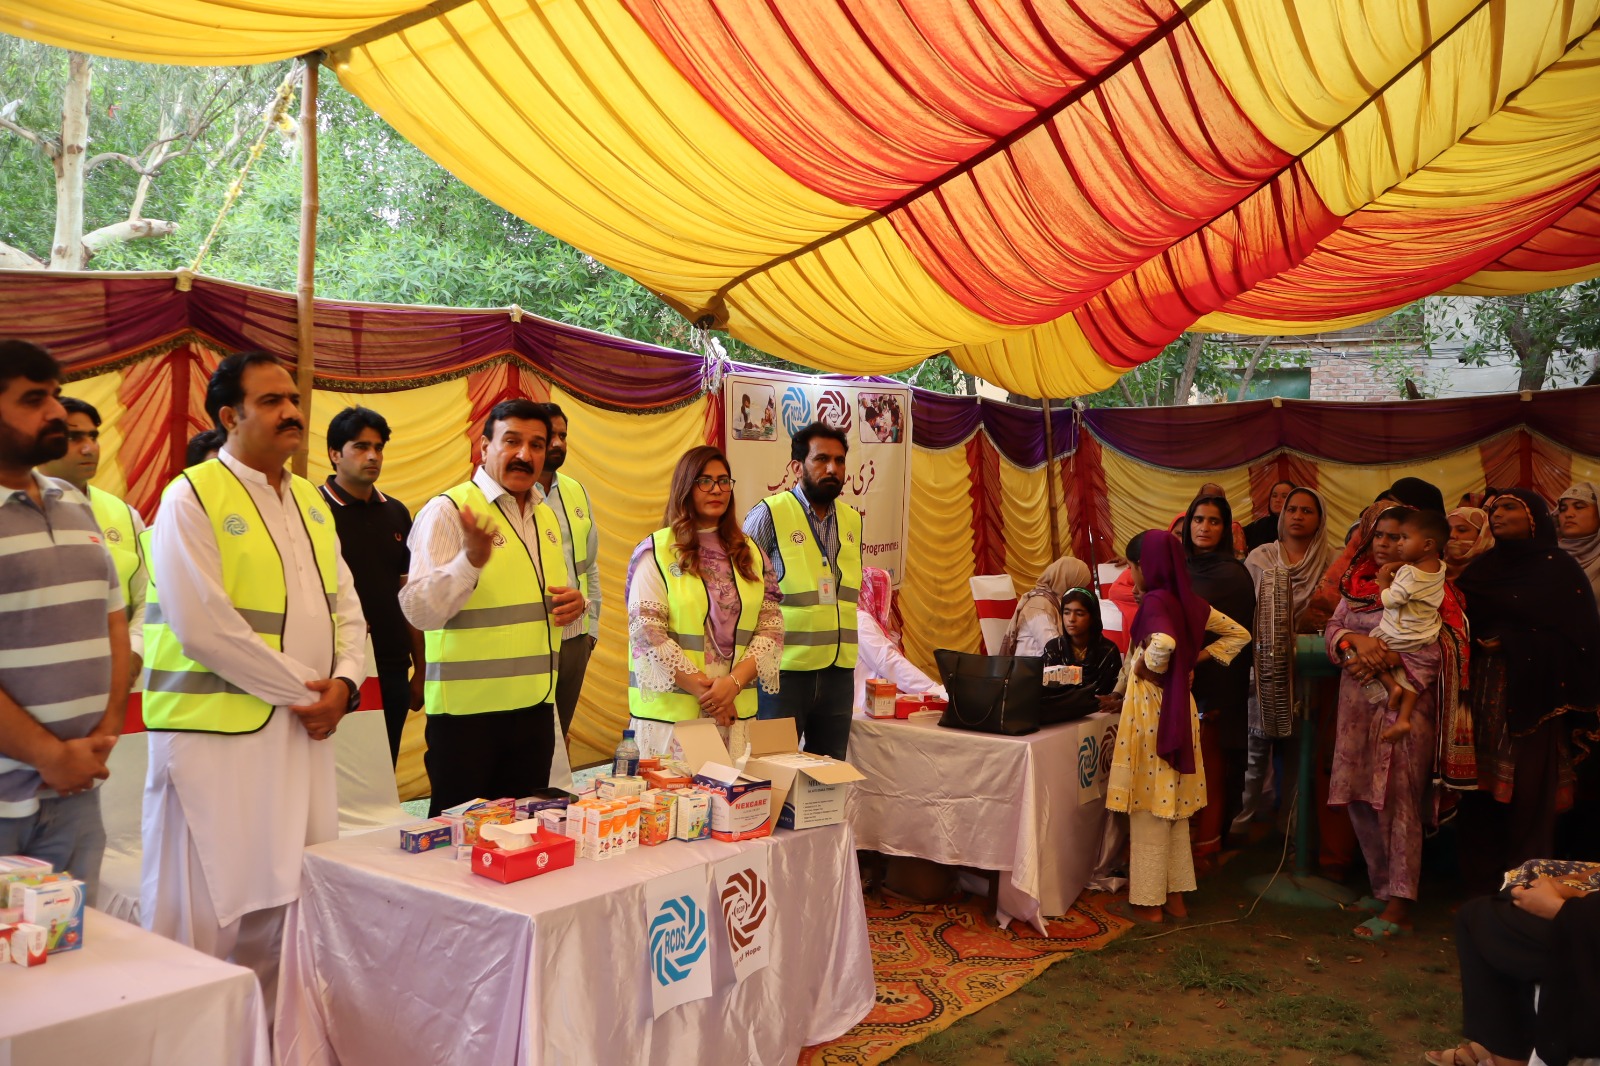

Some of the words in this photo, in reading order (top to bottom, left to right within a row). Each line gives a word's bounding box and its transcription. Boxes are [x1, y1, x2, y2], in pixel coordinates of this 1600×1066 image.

[735, 799, 768, 810] NEXCARE
[664, 925, 686, 955] RCDS
[745, 945, 762, 958] Hope
